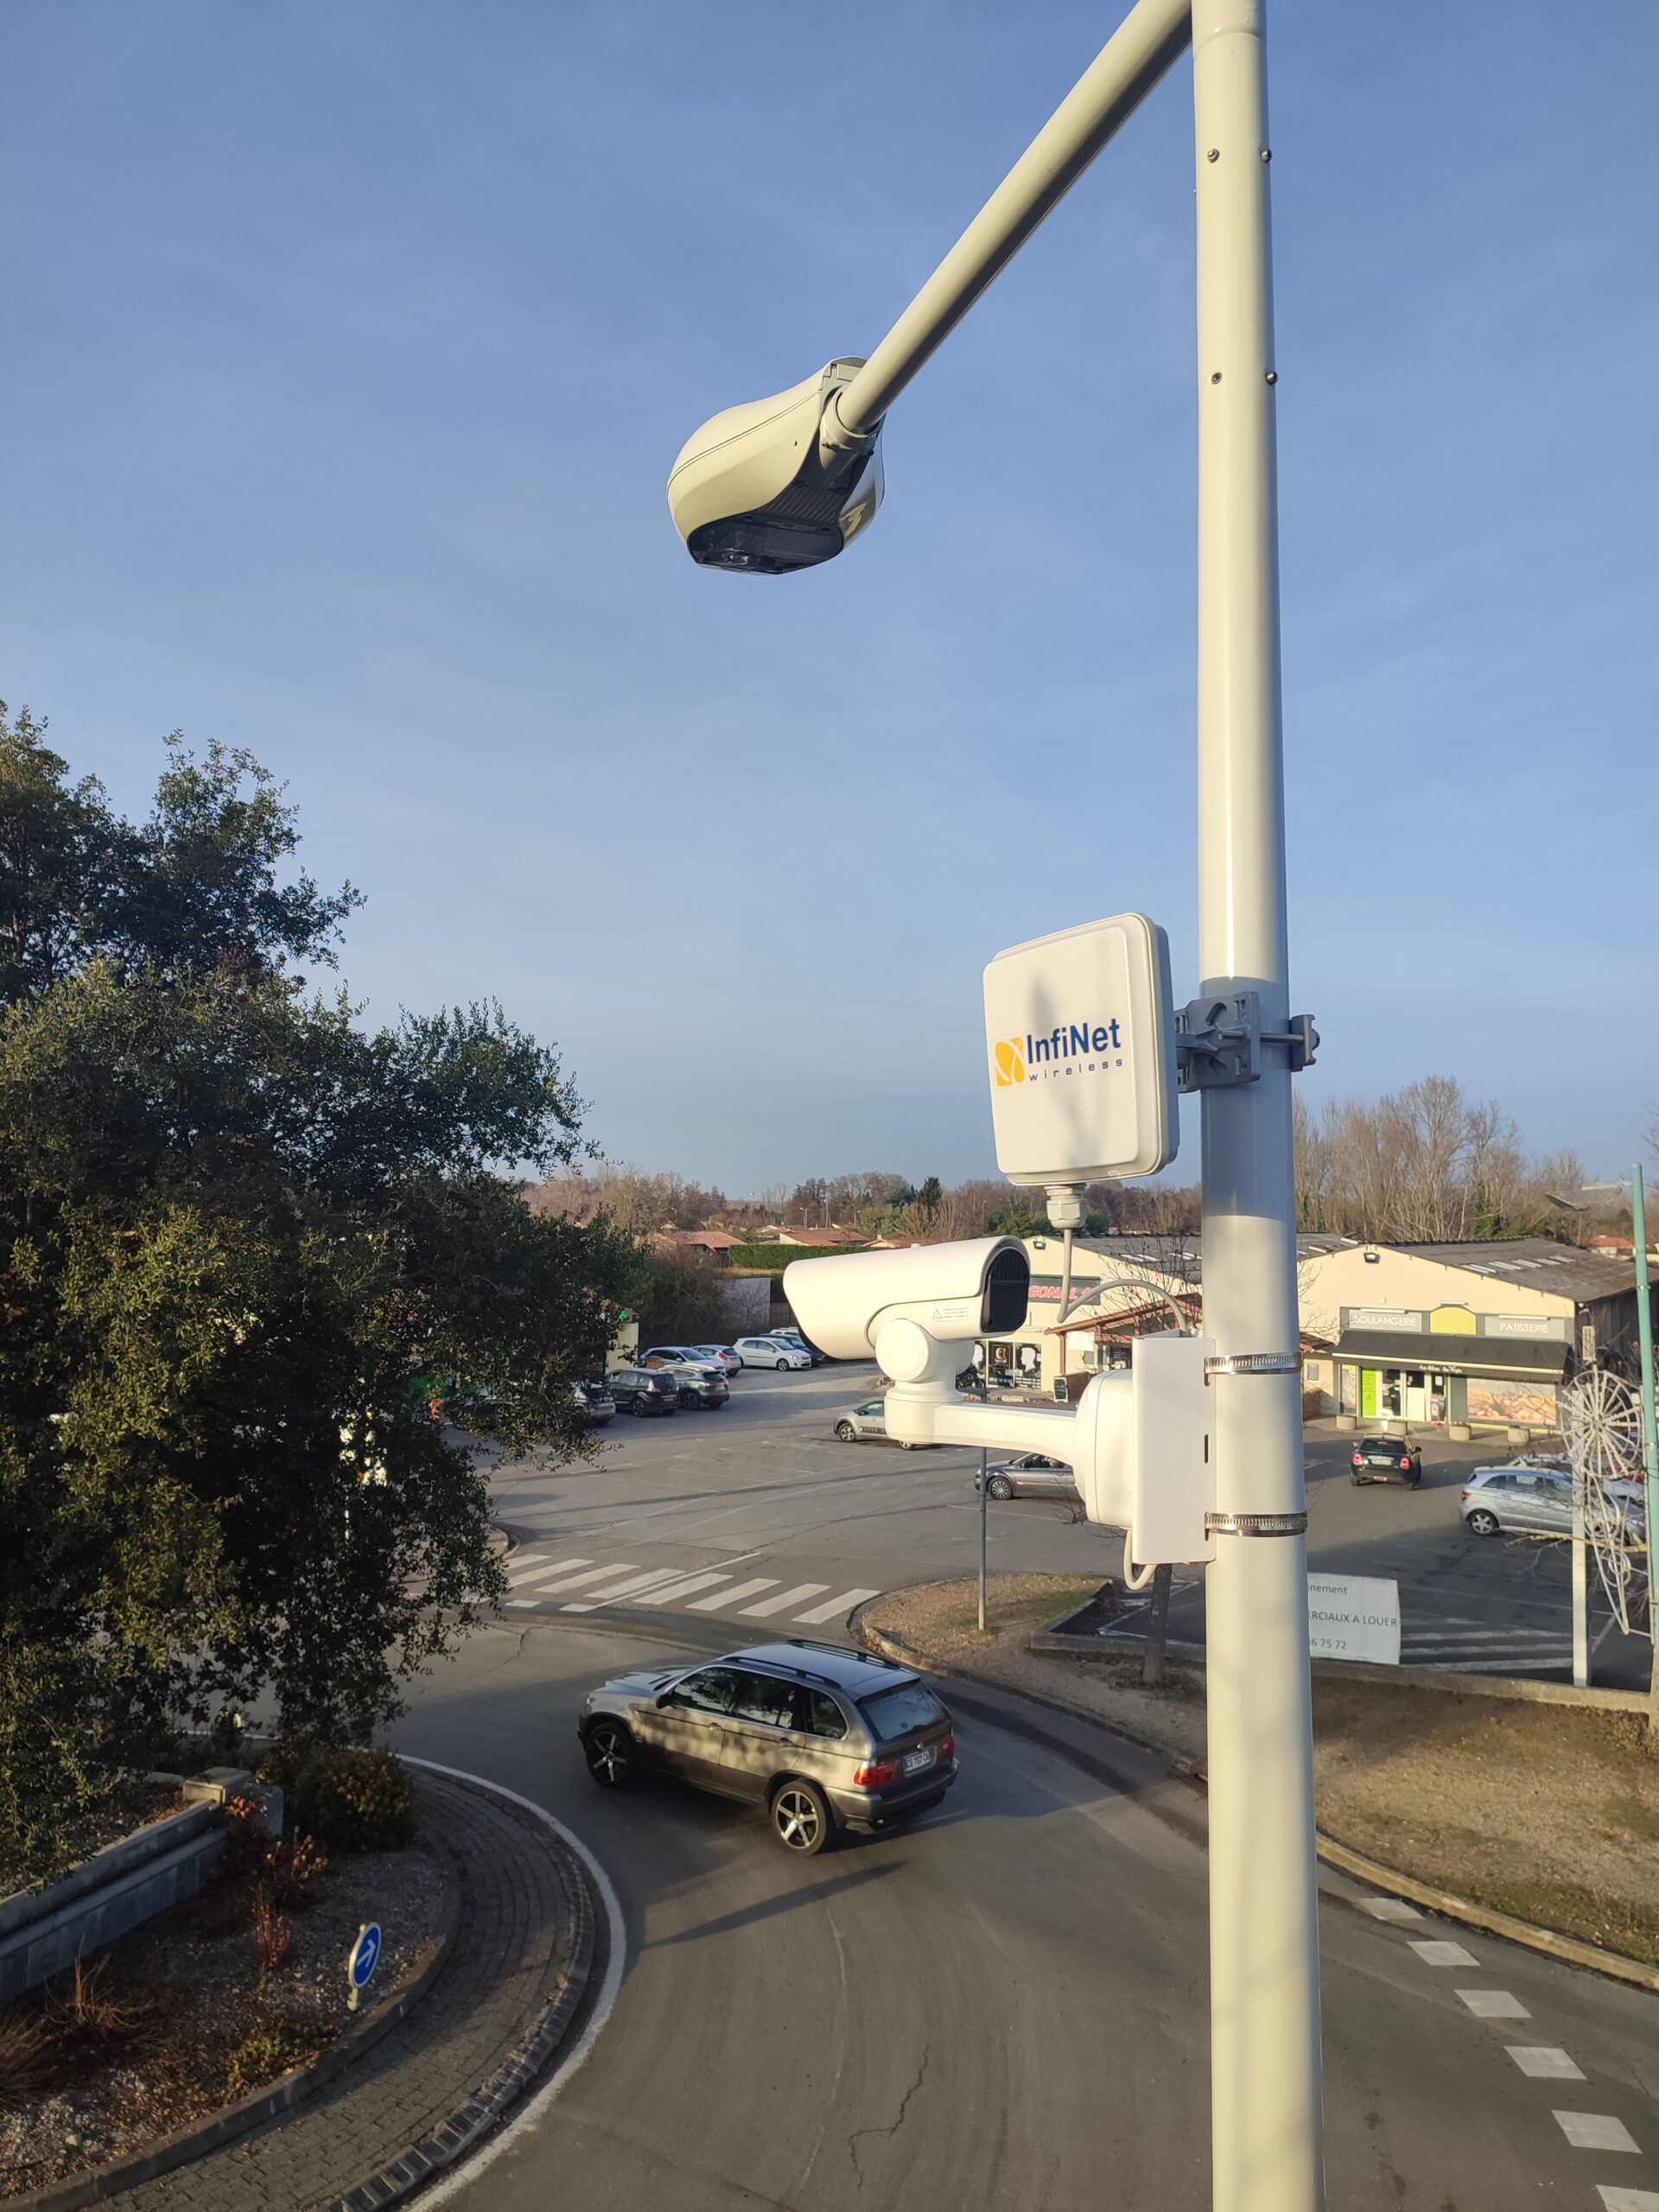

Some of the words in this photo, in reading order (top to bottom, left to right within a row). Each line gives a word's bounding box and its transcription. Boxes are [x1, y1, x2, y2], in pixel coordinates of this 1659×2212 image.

[1027, 1019, 1121, 1064] InfiNet
[1029, 1058, 1122, 1081] wireless
[1028, 1285, 1077, 1300] GONL
[1499, 1322, 1549, 1333] PATISSERIE
[1352, 1615, 1359, 1624] A
[1363, 1616, 1397, 1627] LOUER
[1319, 1637, 1332, 1648] 75
[1333, 1639, 1347, 1649] 72
